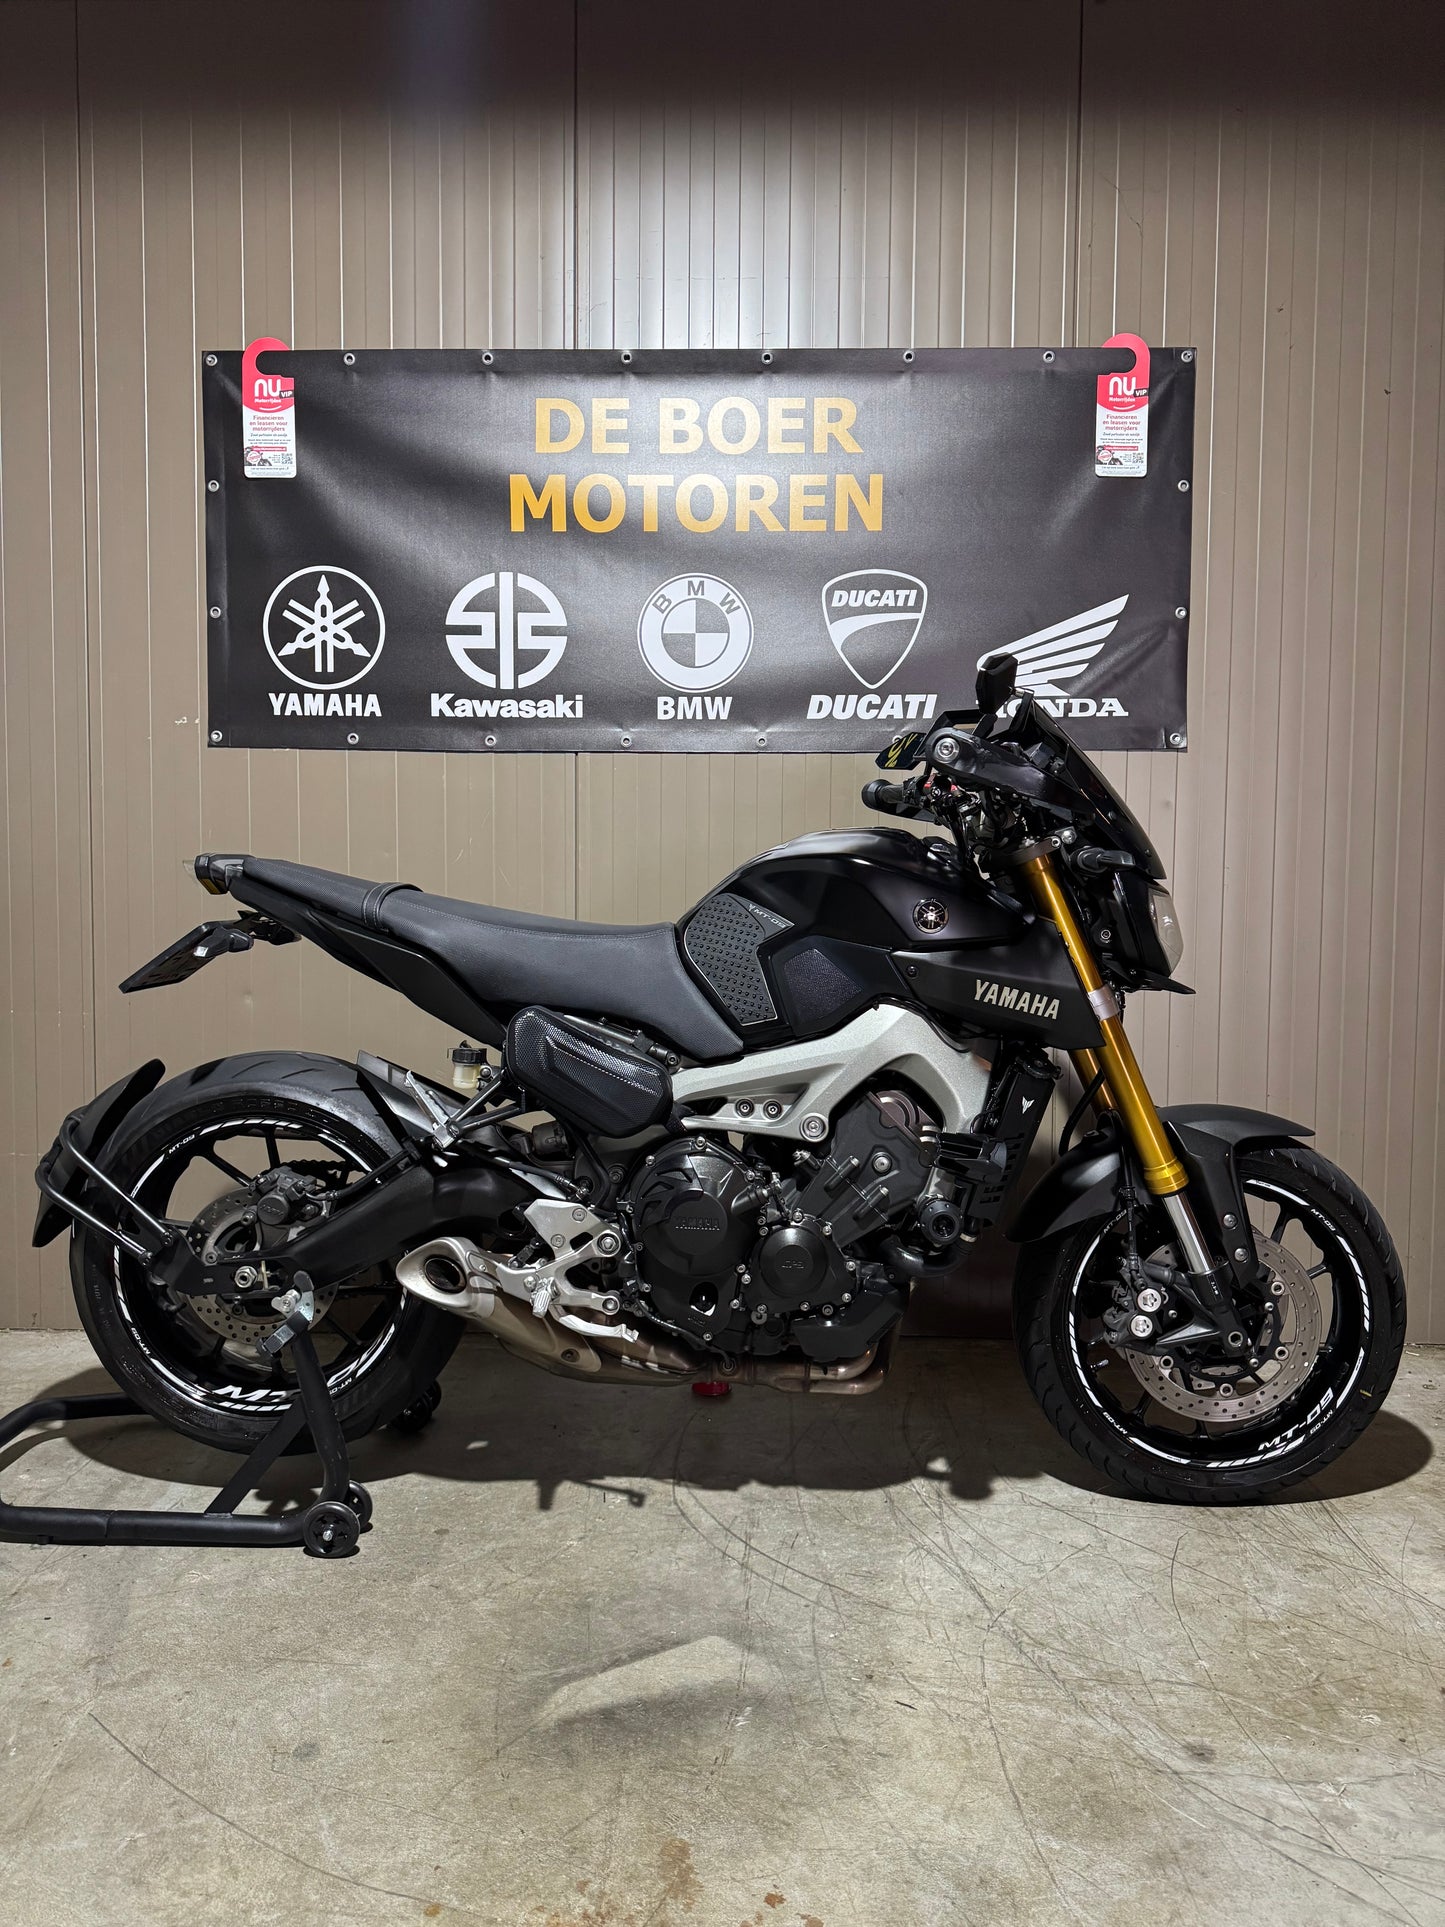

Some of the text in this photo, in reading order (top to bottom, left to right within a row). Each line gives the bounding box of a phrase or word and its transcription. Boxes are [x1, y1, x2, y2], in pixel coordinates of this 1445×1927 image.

[280, 390, 293, 398] VIP
[1135, 389, 1147, 397] VIP
[535, 397, 864, 455] DE BOER
[509, 473, 885, 534] MOTOREN
[651, 580, 742, 615] BMW
[831, 589, 918, 608] DUCATI
[268, 692, 382, 717] YAMAHA
[430, 693, 584, 719] Kawasaki
[657, 697, 733, 721] BMW
[806, 693, 938, 720] DUCATI
[976, 697, 1129, 719] NDA
[754, 908, 786, 929] MT-09
[974, 979, 1060, 1020] YAMAHA
[168, 1133, 195, 1154] MT-09
[673, 1216, 721, 1231] YAMAHA
[1311, 1208, 1336, 1231] MT-09
[131, 1327, 152, 1355] MT-09
[1102, 1411, 1128, 1435] MT-09
[1257, 1386, 1334, 1451] MT-09
[1310, 1410, 1333, 1434] MT-09
